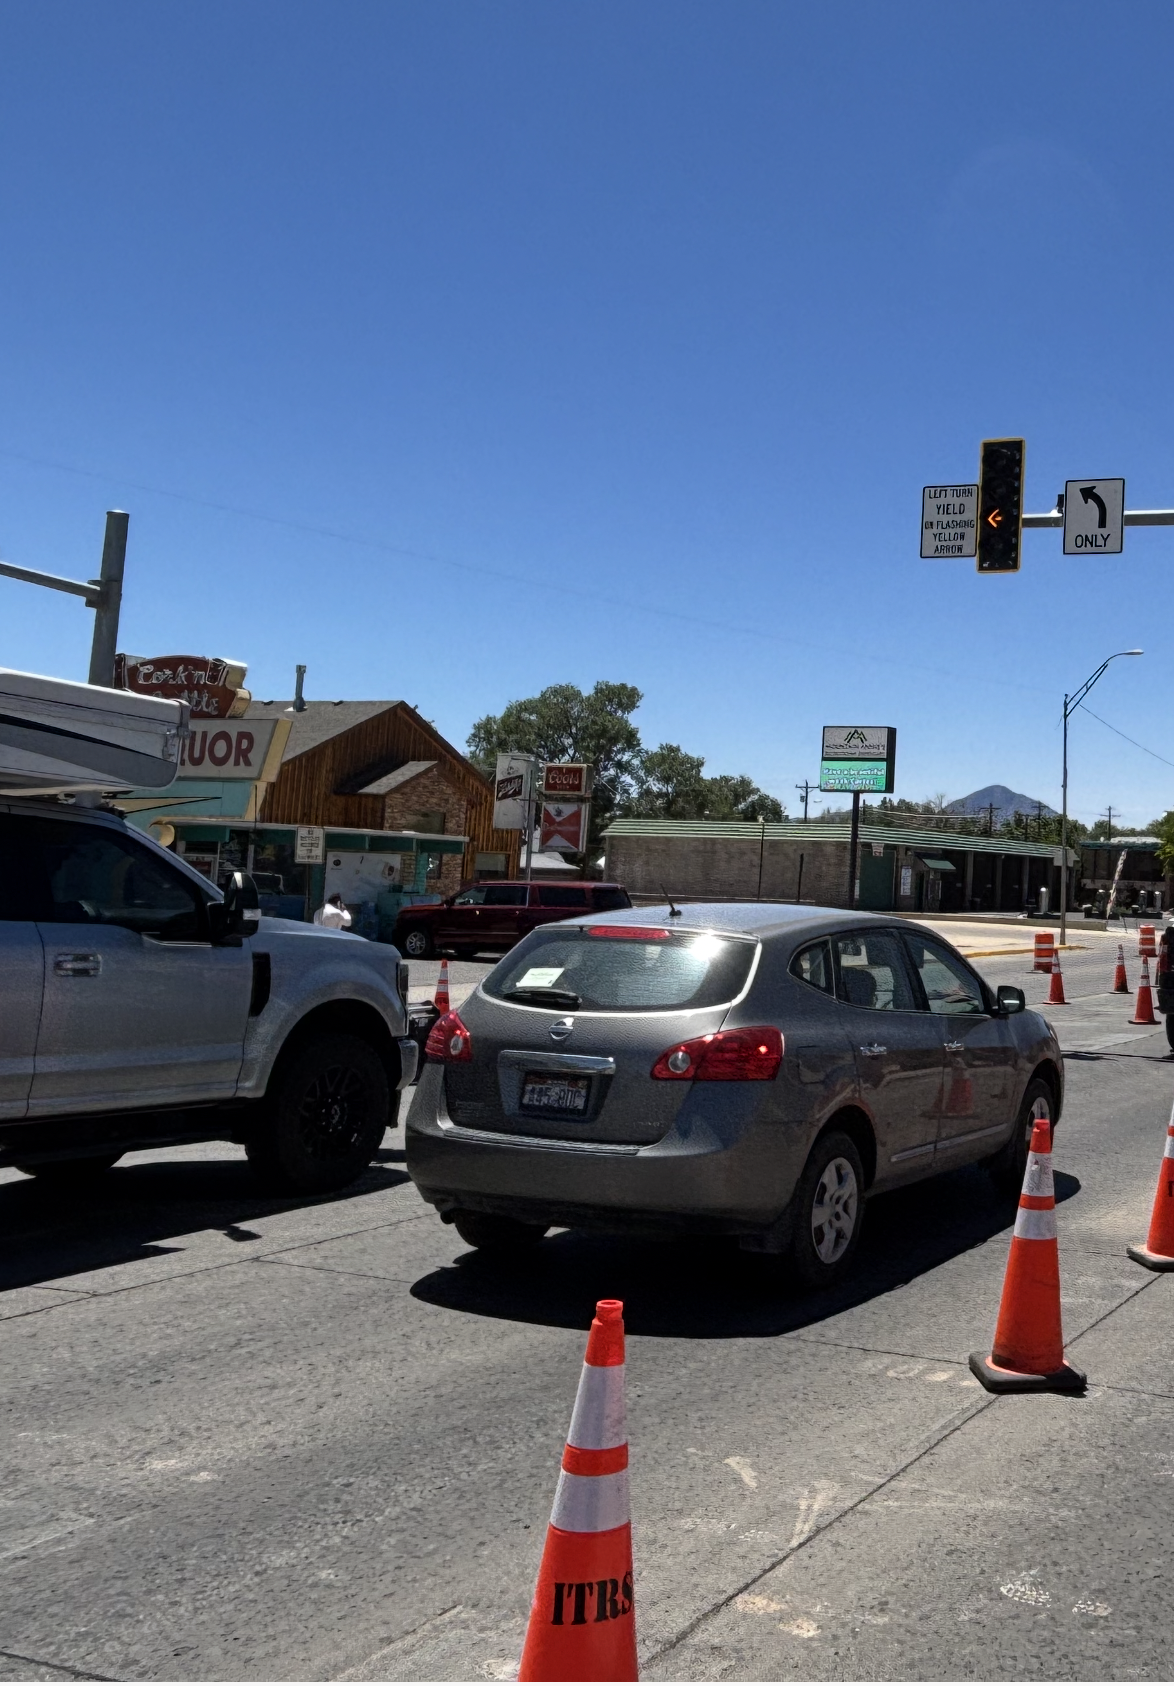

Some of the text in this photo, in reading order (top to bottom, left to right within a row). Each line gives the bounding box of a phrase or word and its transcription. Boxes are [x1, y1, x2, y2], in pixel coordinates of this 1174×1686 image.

[928, 488, 973, 500] LEFT TURN
[936, 503, 966, 515] YIELD
[936, 519, 975, 530] FLASHING
[932, 532, 966, 542] YELLOW
[1074, 533, 1111, 548] ONLY
[933, 544, 964, 554] ARROW
[551, 1570, 633, 1626] ITRS
